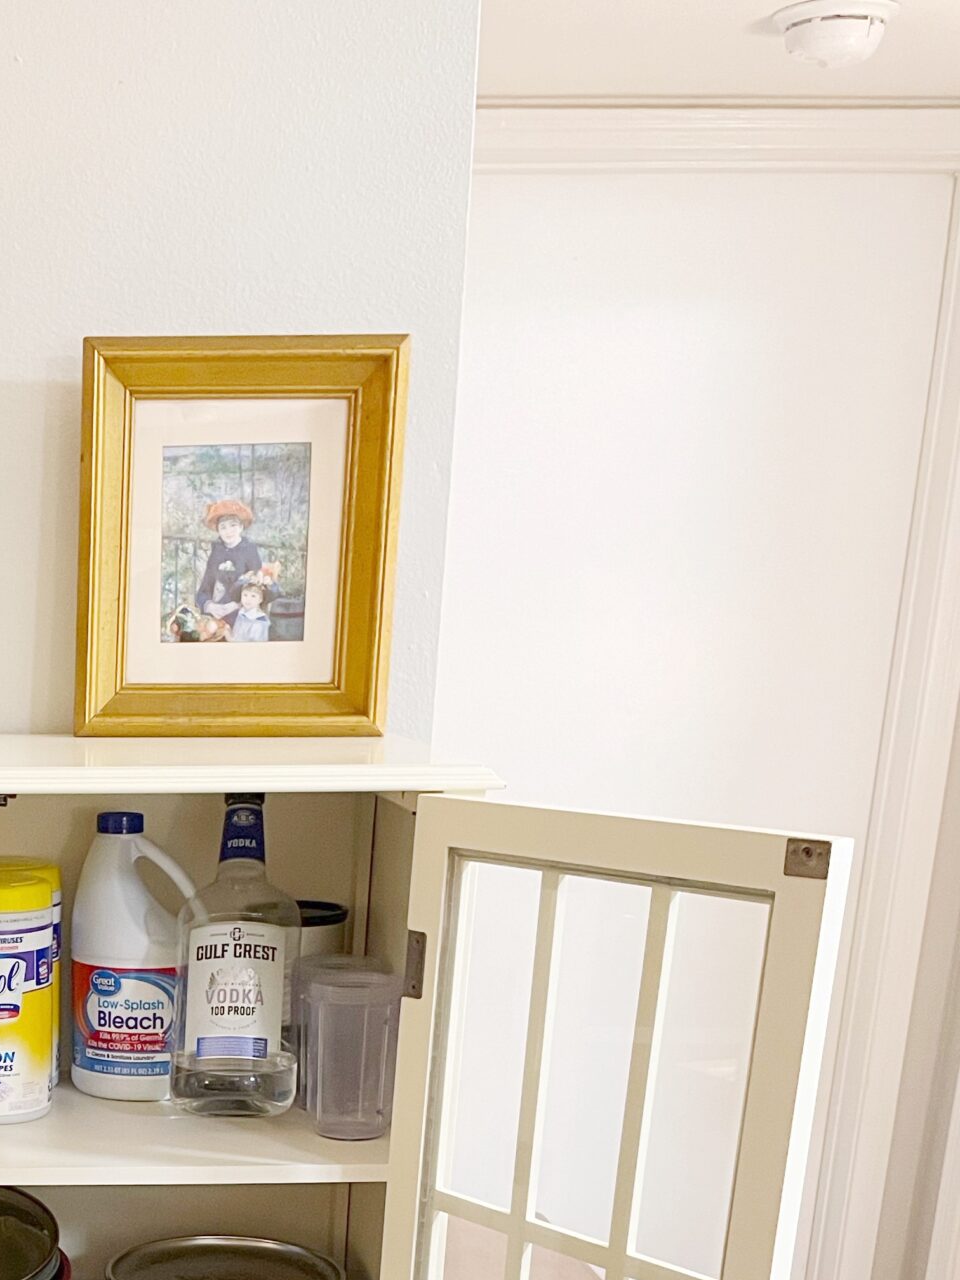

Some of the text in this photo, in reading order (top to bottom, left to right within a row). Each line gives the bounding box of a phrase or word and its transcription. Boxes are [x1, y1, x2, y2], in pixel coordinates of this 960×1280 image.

[227, 838, 257, 848] VODKA
[196, 943, 278, 962] GULF CREST
[93, 975, 115, 986] Great
[205, 988, 264, 1006] VODKA
[97, 997, 165, 1012] Low-Splash
[210, 1006, 256, 1016] 100 PROOF
[97, 1010, 165, 1030] Bleach
[108, 1041, 142, 1050] COVID-19
